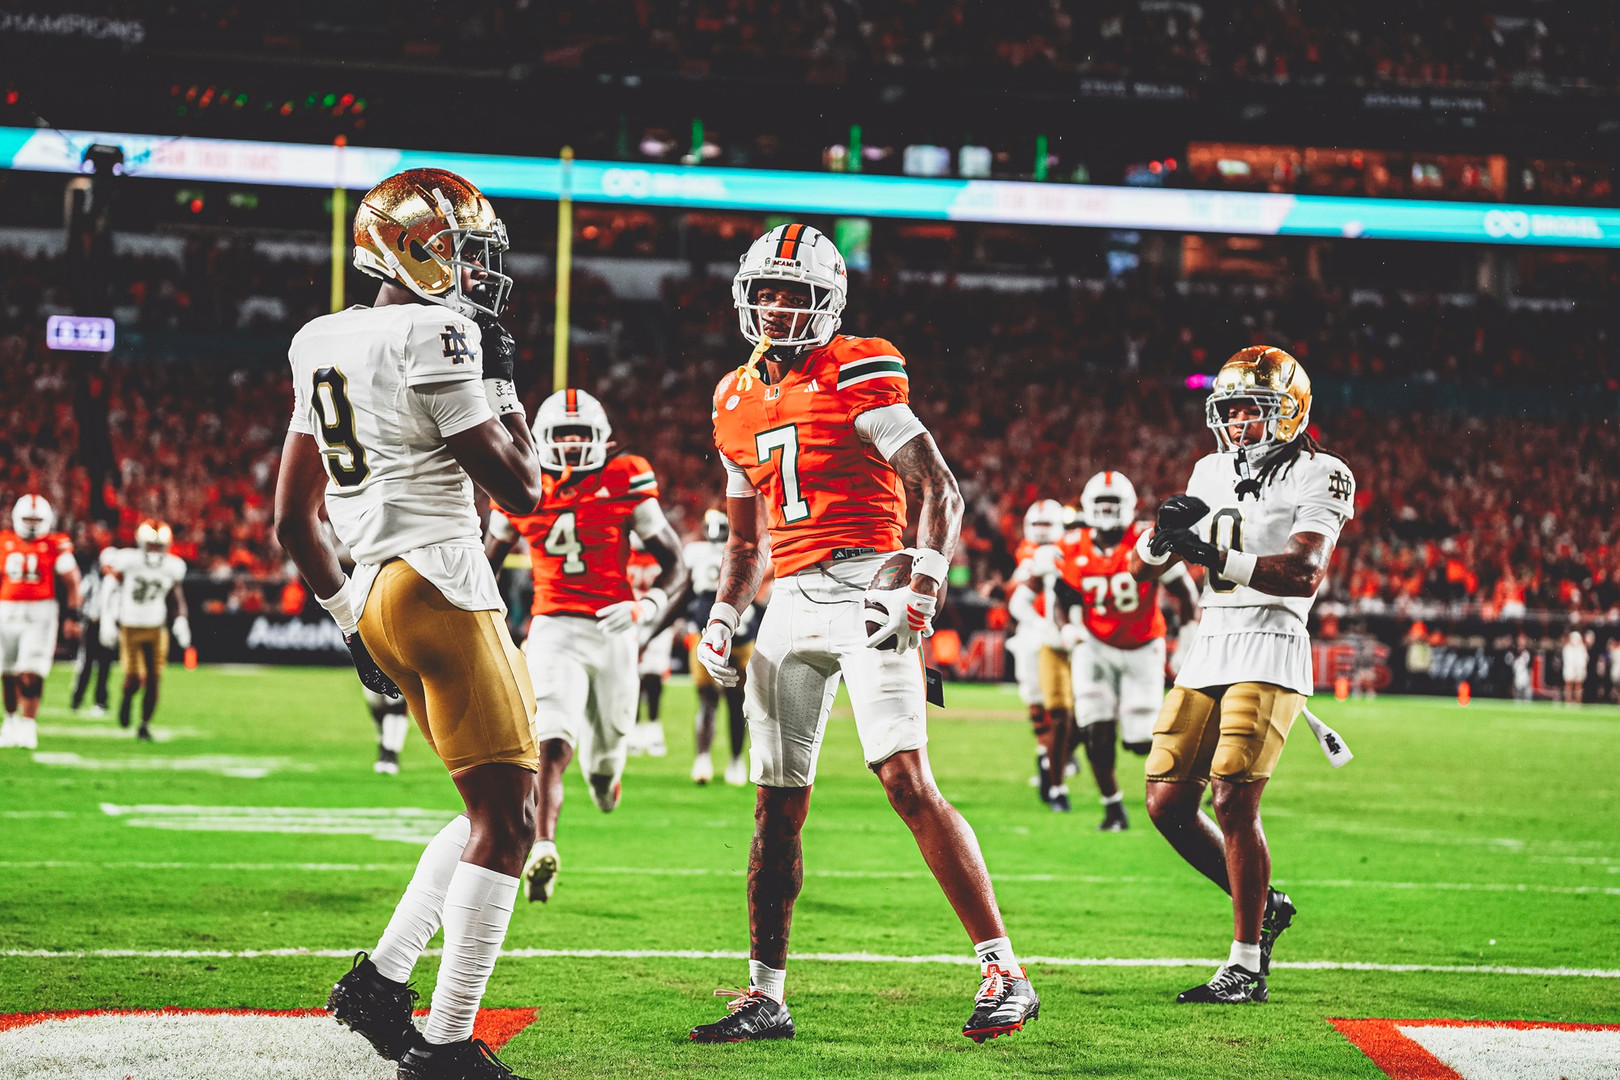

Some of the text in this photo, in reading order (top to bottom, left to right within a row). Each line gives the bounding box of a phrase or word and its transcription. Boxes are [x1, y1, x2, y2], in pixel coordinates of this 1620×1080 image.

[311, 363, 372, 488] 9
[755, 422, 811, 525] 7
[544, 511, 586, 575] 4
[1081, 571, 1139, 613] 78
